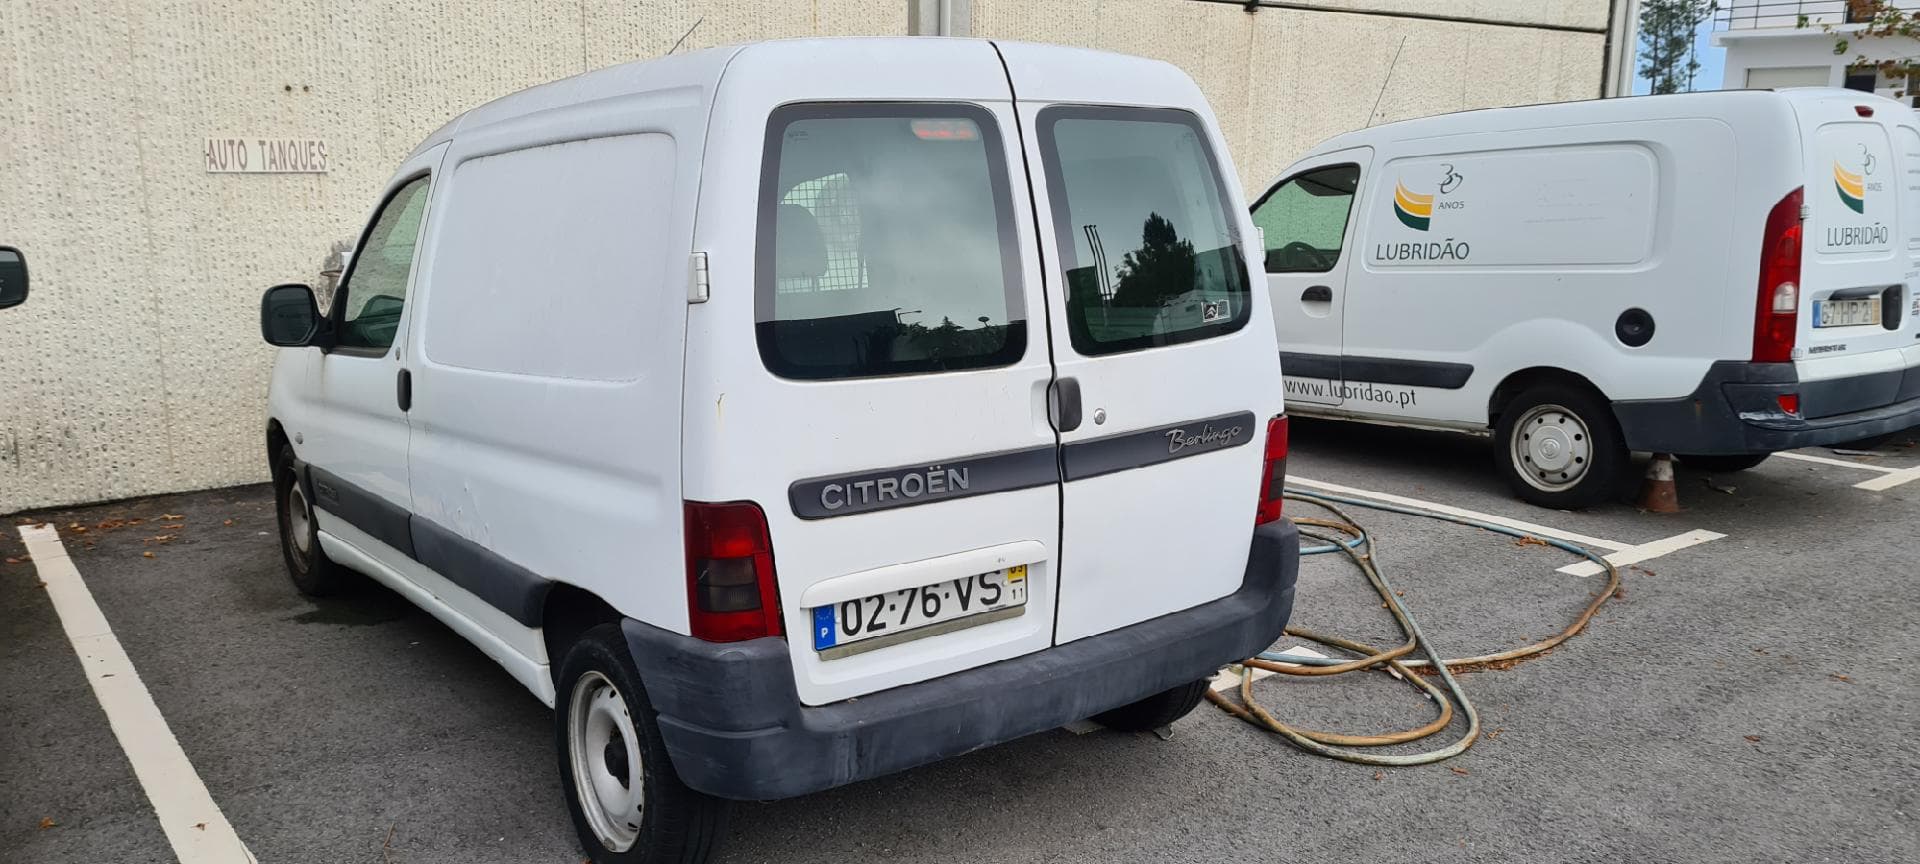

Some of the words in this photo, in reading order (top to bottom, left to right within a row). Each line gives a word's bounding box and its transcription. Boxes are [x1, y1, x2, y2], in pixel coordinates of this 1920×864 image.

[208, 139, 248, 171] AUTO
[258, 140, 327, 171] TANQUES
[1438, 200, 1465, 210] ANOS
[1827, 222, 1888, 247] LUBRIDÃO
[1376, 238, 1470, 261] LUBRIDÃO
[1284, 379, 1417, 409] www.lubridao.pt
[1165, 424, 1242, 453] Berlingo
[821, 465, 969, 510] CITROËN
[1011, 588, 1023, 600] 11
[821, 627, 829, 639] P
